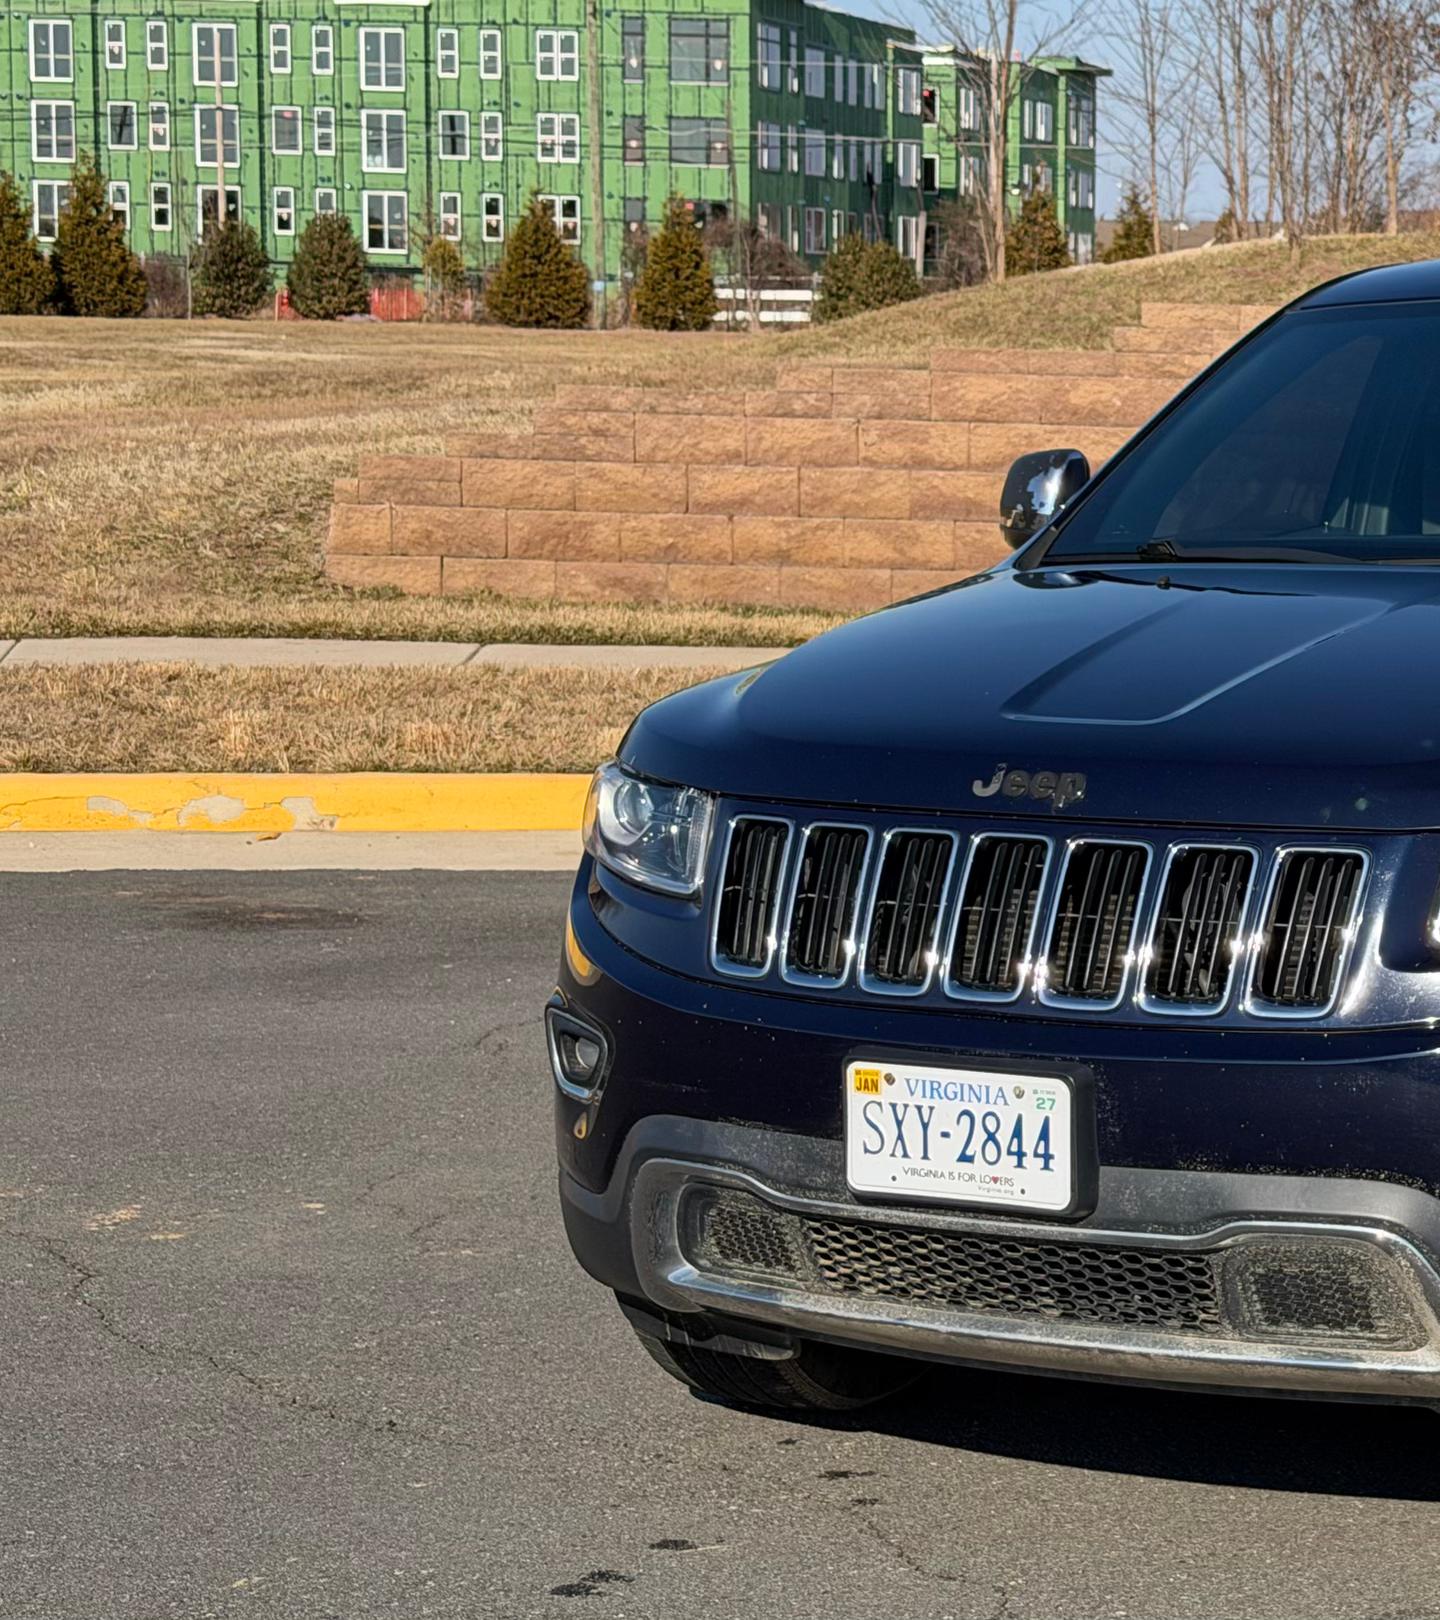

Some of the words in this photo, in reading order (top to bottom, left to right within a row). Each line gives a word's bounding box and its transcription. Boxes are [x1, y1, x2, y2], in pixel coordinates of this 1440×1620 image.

[972, 763, 1087, 814] Jeep
[855, 1076, 879, 1093] JAN
[903, 1078, 1010, 1106] VIRGINIA
[1036, 1097, 1056, 1111] 27
[862, 1100, 1055, 1172] SXY-2844
[902, 1166, 946, 1180] VIRGINIA
[948, 1171, 956, 1181] IS
[958, 1172, 977, 1183] FOR
